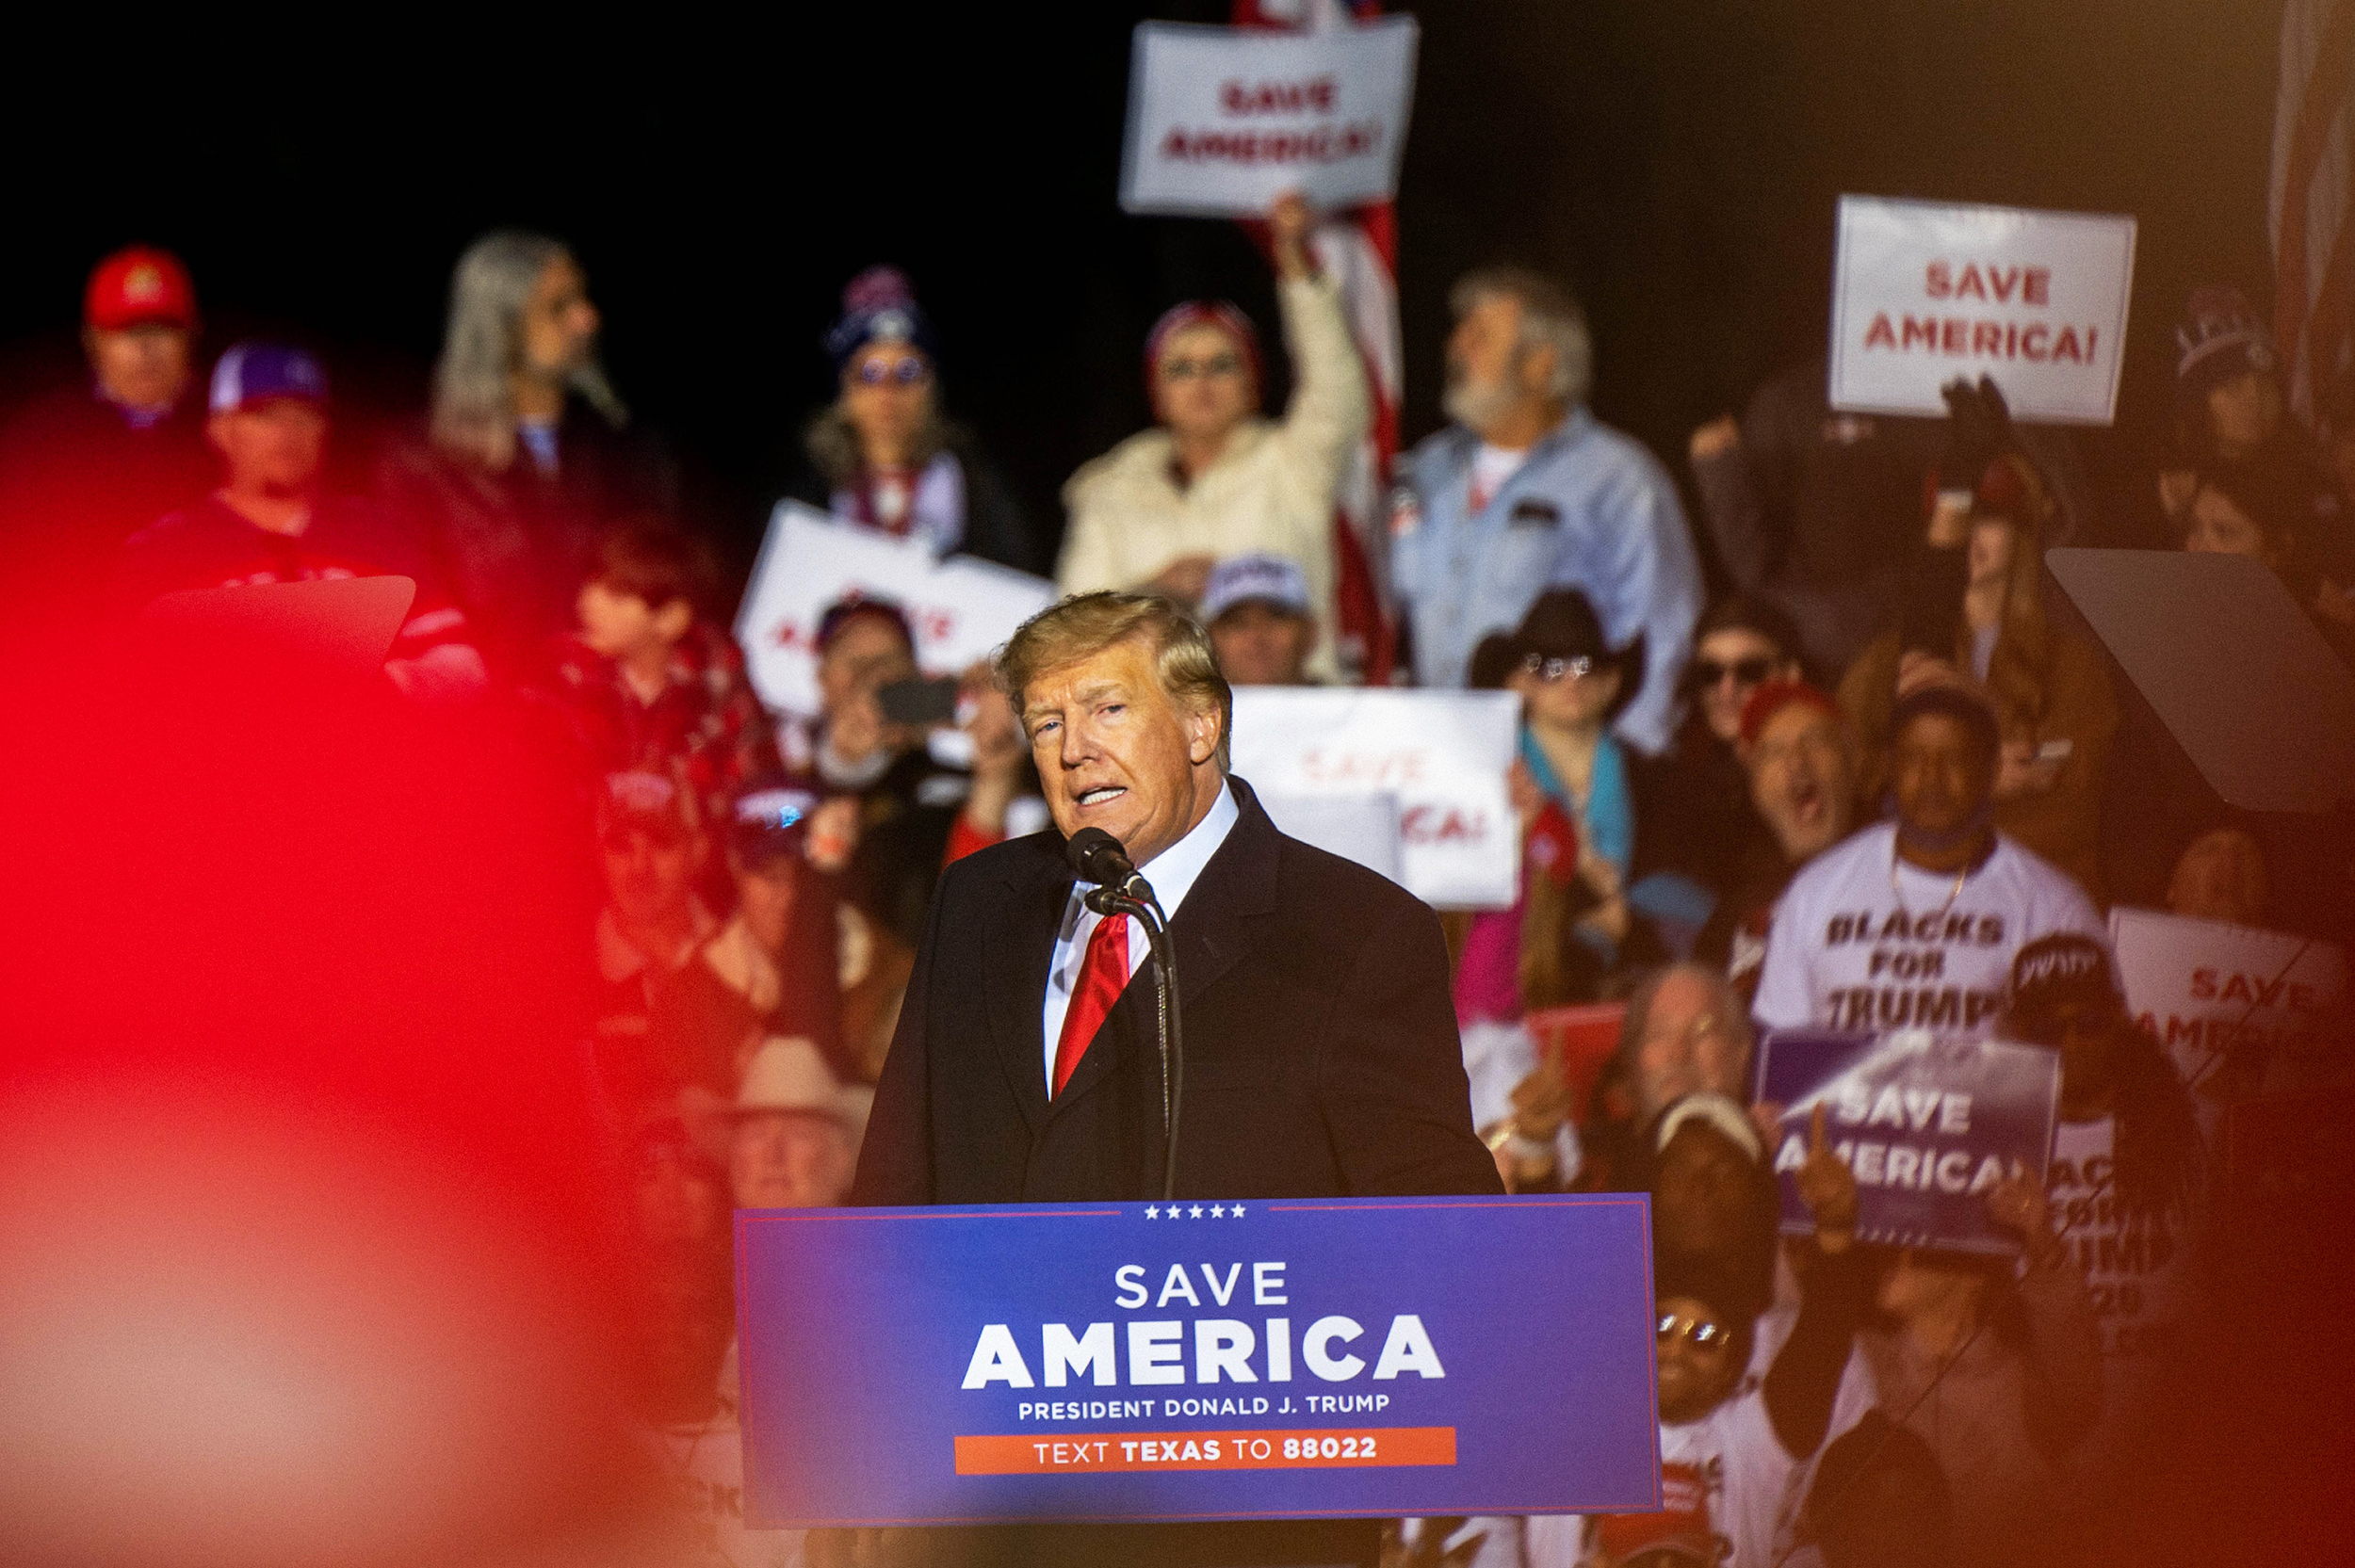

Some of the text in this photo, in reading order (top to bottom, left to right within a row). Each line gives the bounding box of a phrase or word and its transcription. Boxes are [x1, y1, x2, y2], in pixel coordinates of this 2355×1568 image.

[1926, 258, 2050, 307] SAVE
[1864, 311, 2098, 365] AMERICA!
[1827, 910, 2004, 946] BLACKS
[1869, 948, 1946, 979] FOR
[1828, 987, 1996, 1031] TRUMP
[2191, 967, 2314, 1013] SAVE
[1835, 1085, 1973, 1135] SAVE
[1114, 1262, 1289, 1309] SAVE
[961, 1314, 1446, 1390] AMERICA
[1018, 1395, 1389, 1421] PRESIDENT DONALD J. TRUMP
[1033, 1437, 1377, 1464] TEXT TEXAS TO 88022
